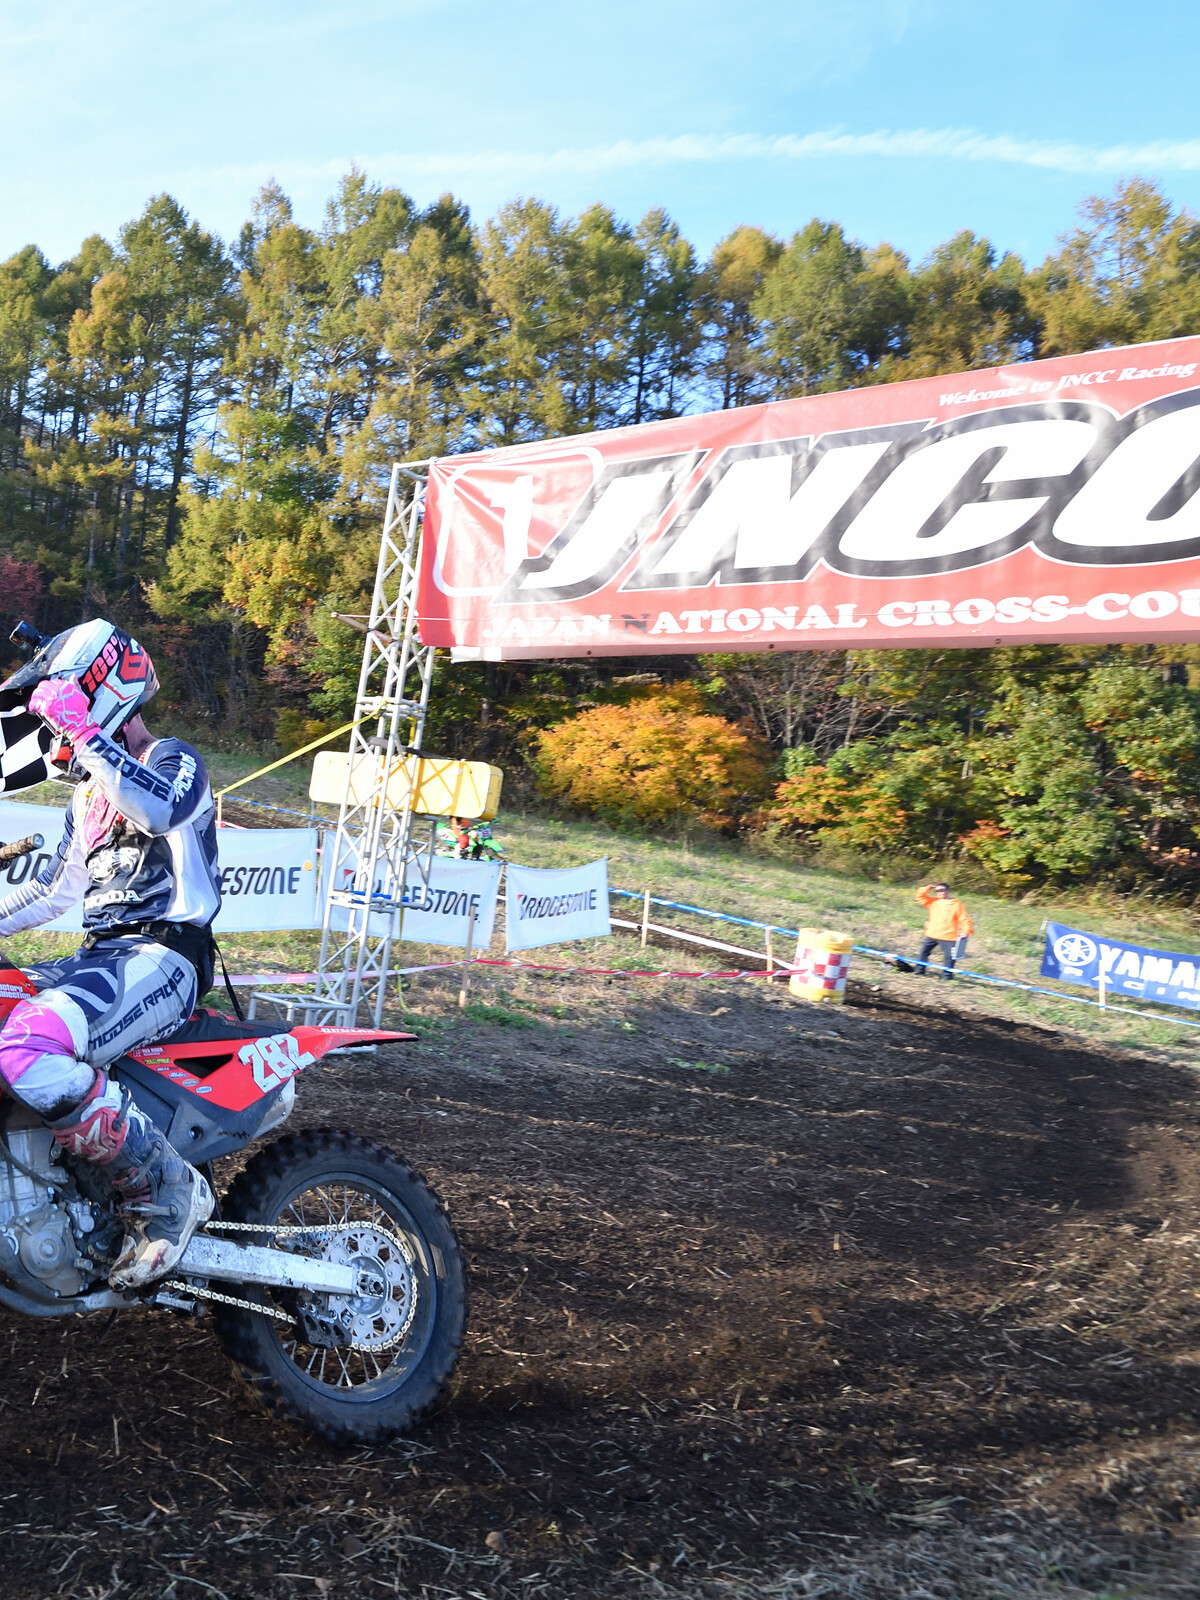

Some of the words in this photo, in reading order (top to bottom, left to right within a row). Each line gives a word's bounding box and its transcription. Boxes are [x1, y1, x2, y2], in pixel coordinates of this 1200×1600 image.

[939, 387, 1025, 407] Welcome
[1029, 381, 1053, 394] to
[1051, 369, 1116, 391] JNCC
[1116, 362, 1199, 383] Racing
[481, 614, 612, 638] JAPAN
[622, 603, 865, 635] NATIONAL
[219, 866, 302, 896] ESTONE
[1099, 943, 1200, 991] YAMA
[237, 1033, 316, 1093] 282
